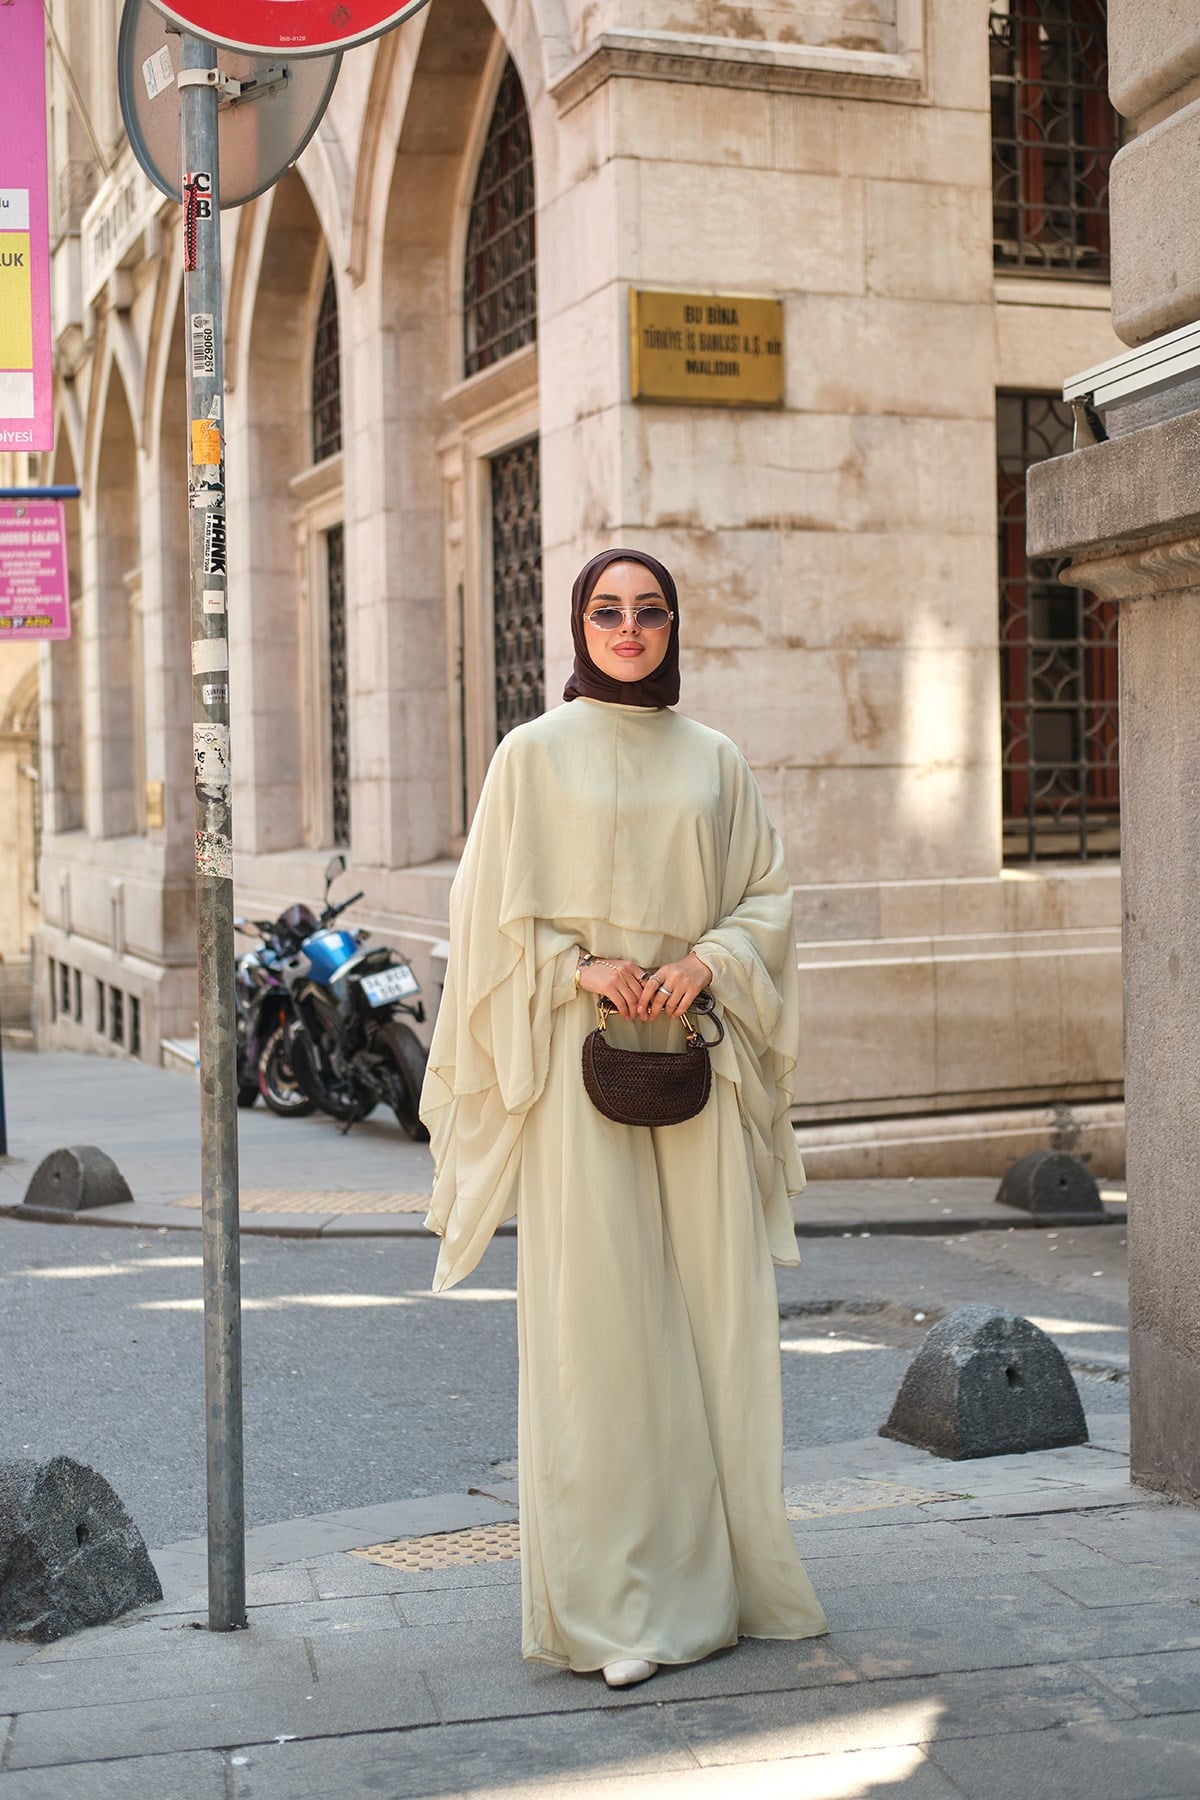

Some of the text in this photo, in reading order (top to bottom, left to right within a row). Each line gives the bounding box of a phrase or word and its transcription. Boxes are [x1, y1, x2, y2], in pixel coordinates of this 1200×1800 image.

[193, 172, 210, 192] C
[196, 199, 211, 218] B
[0, 252, 24, 267] UK
[685, 304, 740, 325] BU BİNA
[643, 324, 682, 350] TÜRKİYE
[203, 328, 214, 373] 0906261
[0, 429, 33, 443] İYESİ
[210, 514, 226, 574] HANK
